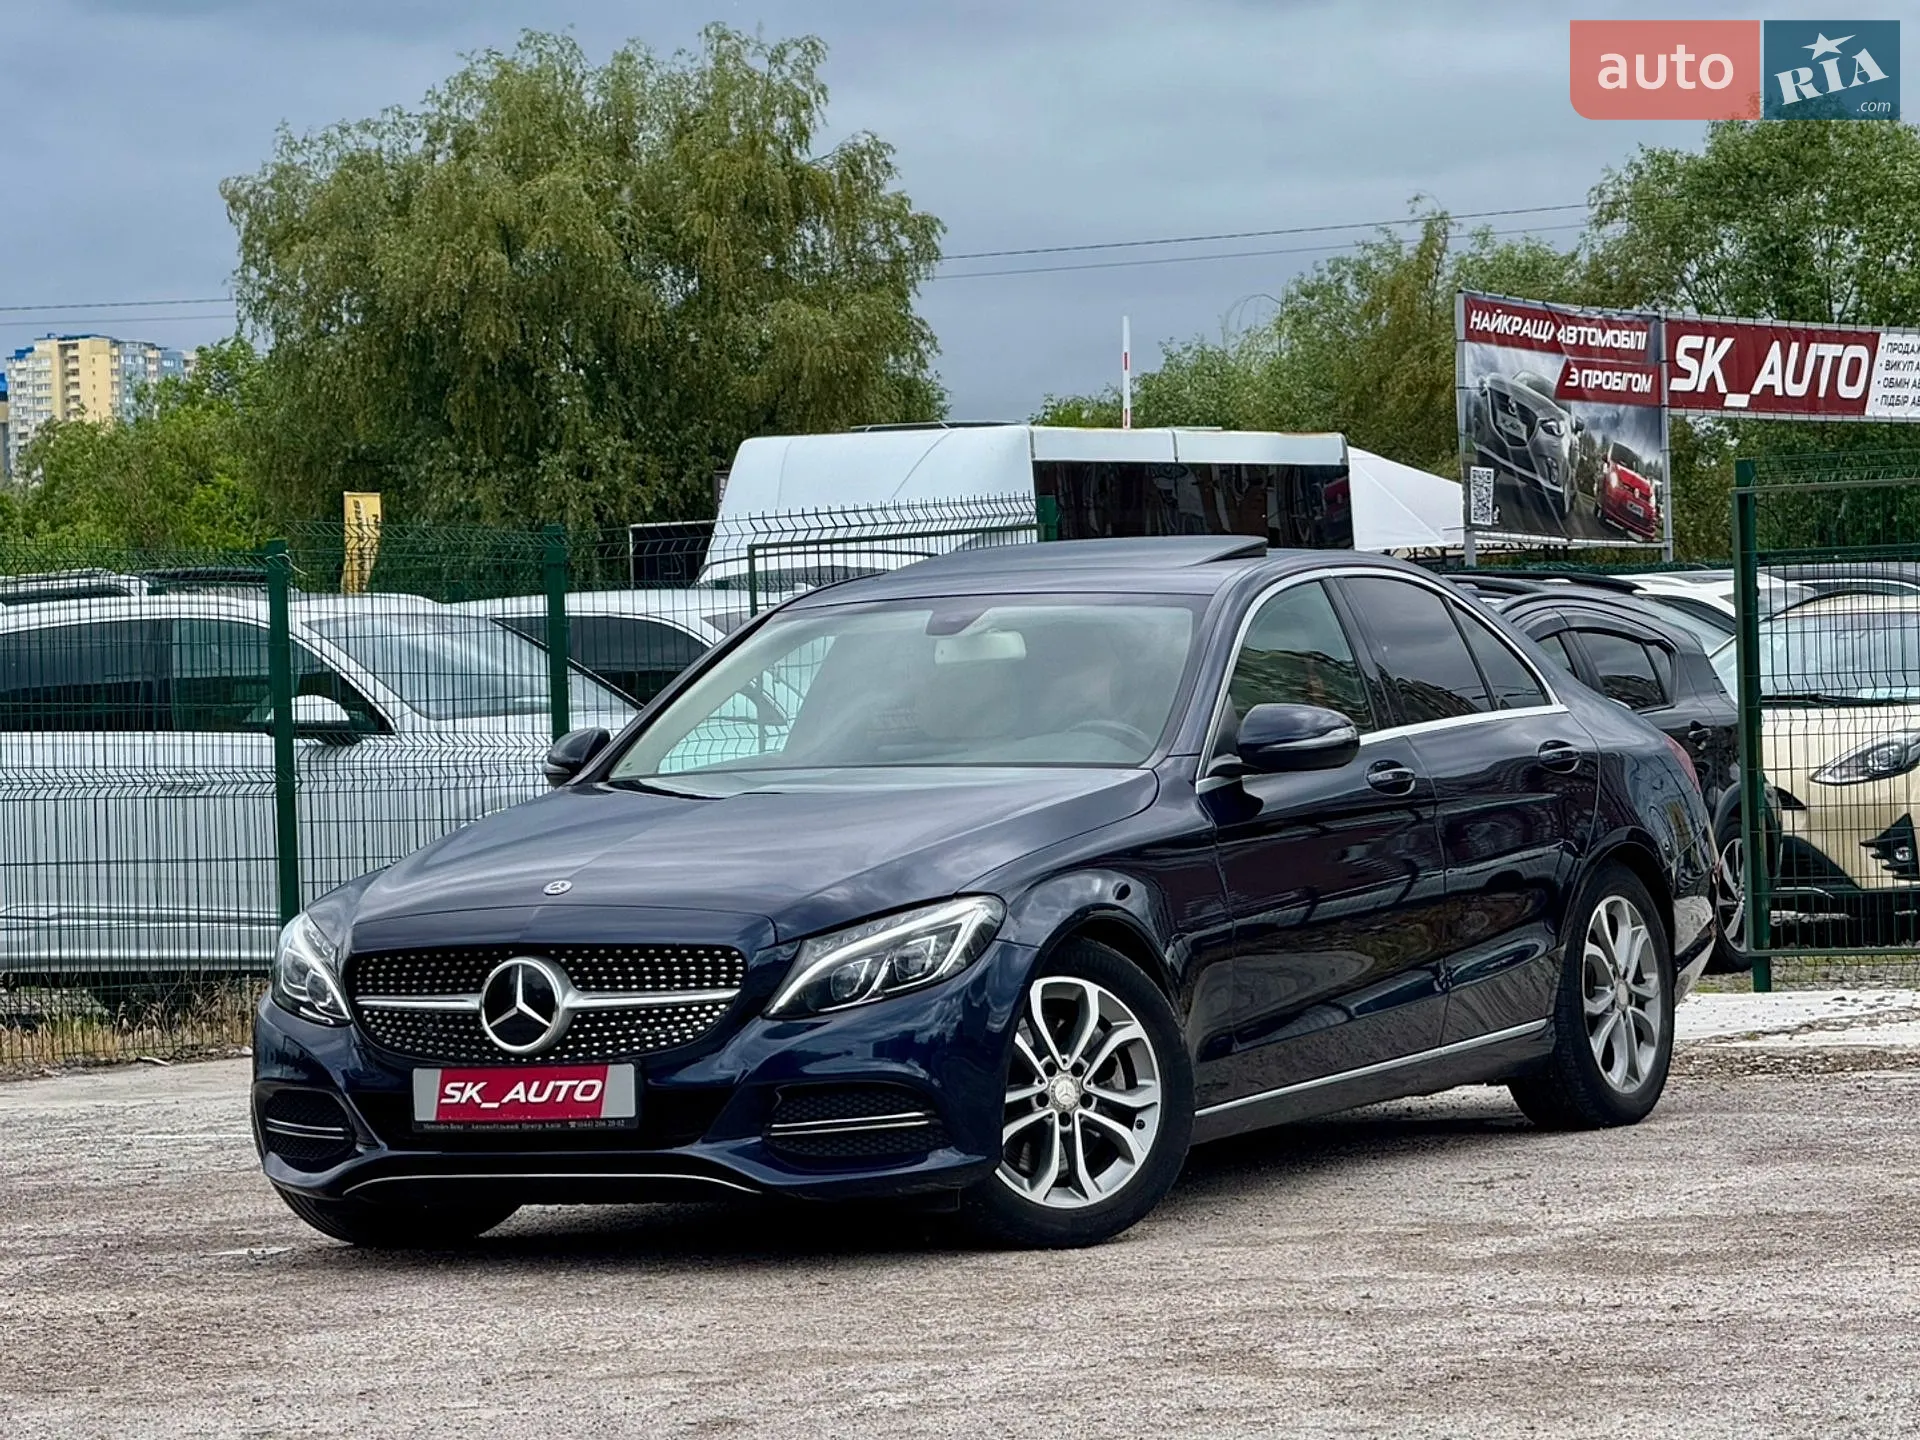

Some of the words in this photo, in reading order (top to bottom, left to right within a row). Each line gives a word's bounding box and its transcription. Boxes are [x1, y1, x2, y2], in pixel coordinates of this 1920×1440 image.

[1469, 309, 1555, 343] НАЙКРАЩІ
[1557, 324, 1647, 350] АВТОМОБІЛІ
[1669, 335, 1870, 408] SK_AUTO
[1884, 360, 1914, 371] ВИКУП
[1565, 367, 1579, 388] З
[1581, 369, 1653, 393] ПРОБІГОМ
[1882, 377, 1910, 389] ОБМІН
[1880, 394, 1909, 407] ПІДБІР
[440, 1079, 603, 1108] SK_AUTO
